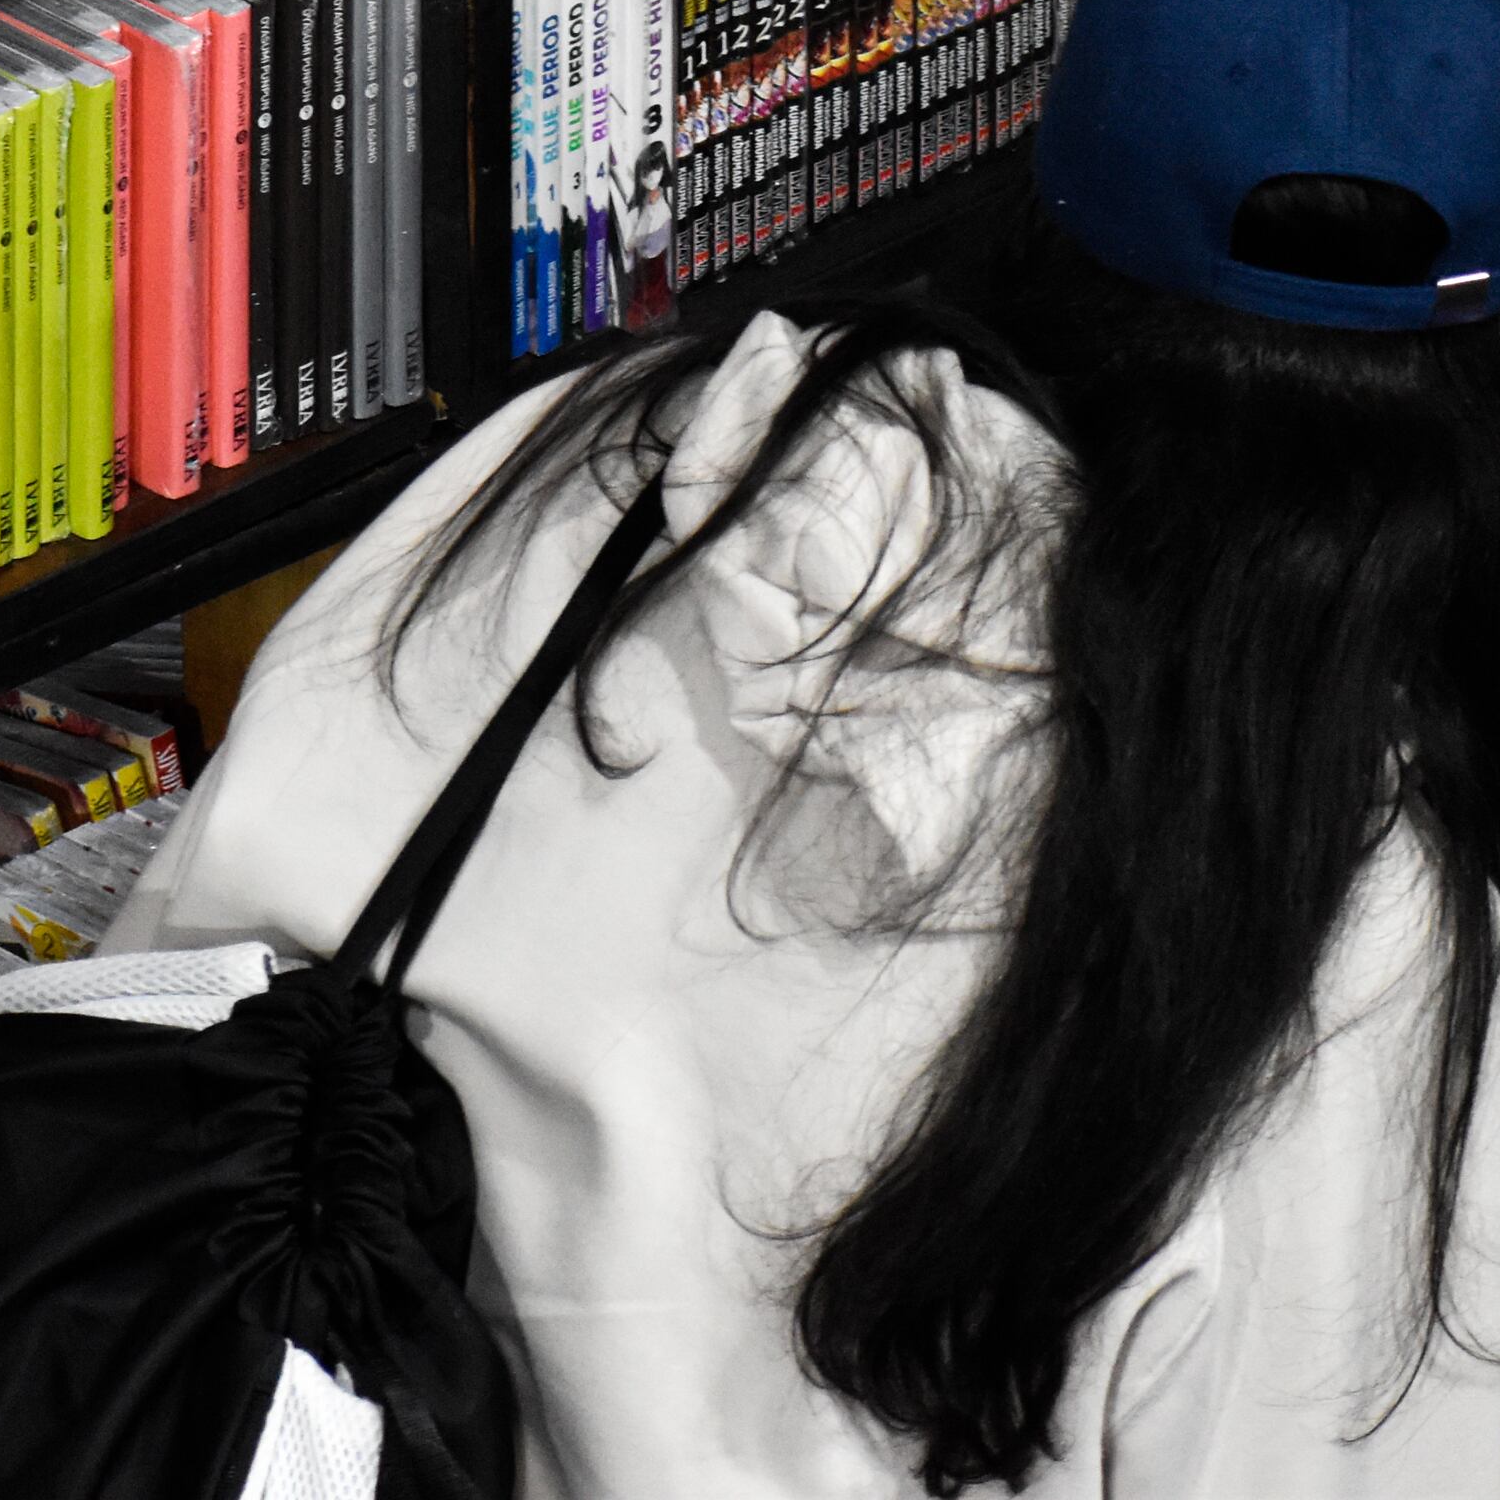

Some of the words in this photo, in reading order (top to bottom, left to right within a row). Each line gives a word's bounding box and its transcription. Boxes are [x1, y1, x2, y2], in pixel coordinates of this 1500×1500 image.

[260, 15, 272, 64] OYASUMI
[541, 13, 560, 100] PERIOD
[567, 1, 584, 88] PERIOD
[649, 28, 663, 97] LOVE
[543, 103, 560, 165] BLUE
[568, 91, 584, 153] BLUE
[642, 103, 663, 136] 3
[788, 103, 800, 160] KURUMADA
[832, 85, 844, 141] KURUMADA
[260, 158, 270, 194] ASANO
[334, 139, 345, 176] ASANO
[572, 171, 581, 190] 3
[256, 370, 274, 436] IVREA
[331, 350, 348, 416] IVREA
[233, 387, 248, 453] IVREA
